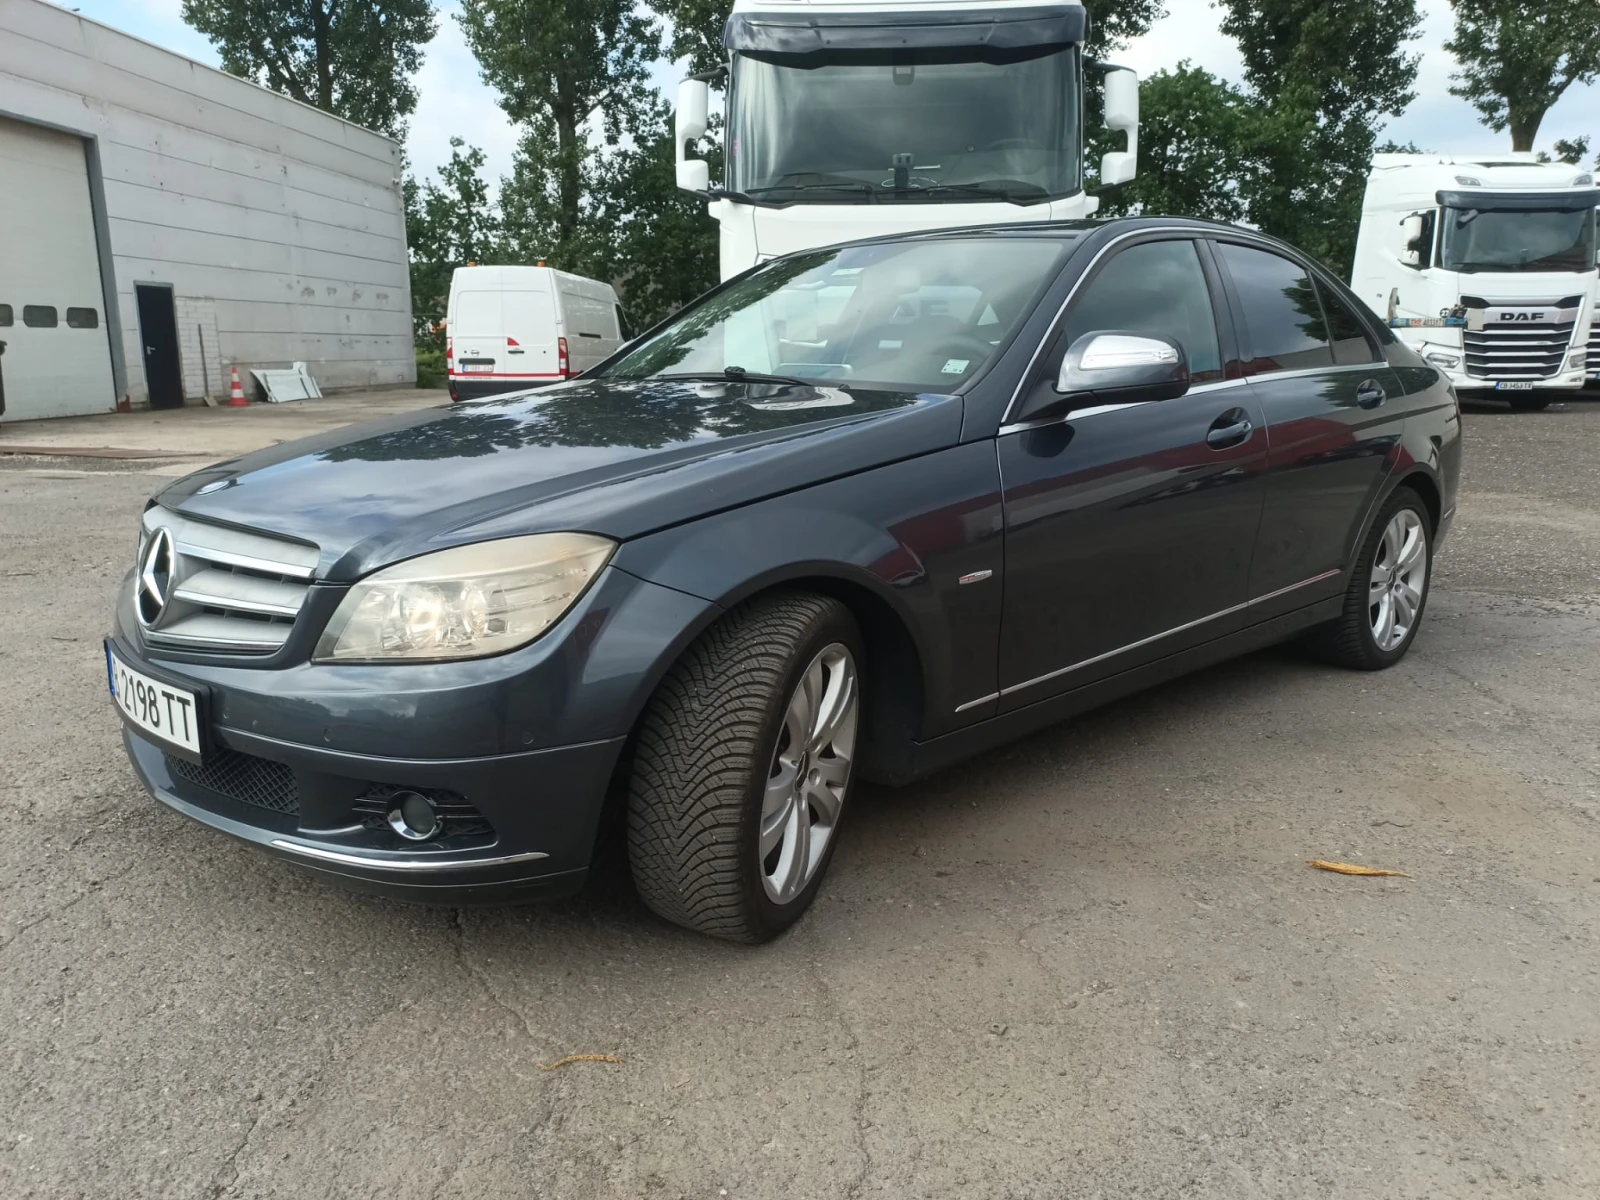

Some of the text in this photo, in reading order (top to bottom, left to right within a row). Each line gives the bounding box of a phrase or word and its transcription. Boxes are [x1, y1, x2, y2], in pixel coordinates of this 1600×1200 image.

[1500, 312, 1545, 321] DAF
[121, 669, 160, 728] 2198
[161, 690, 191, 742] TT
